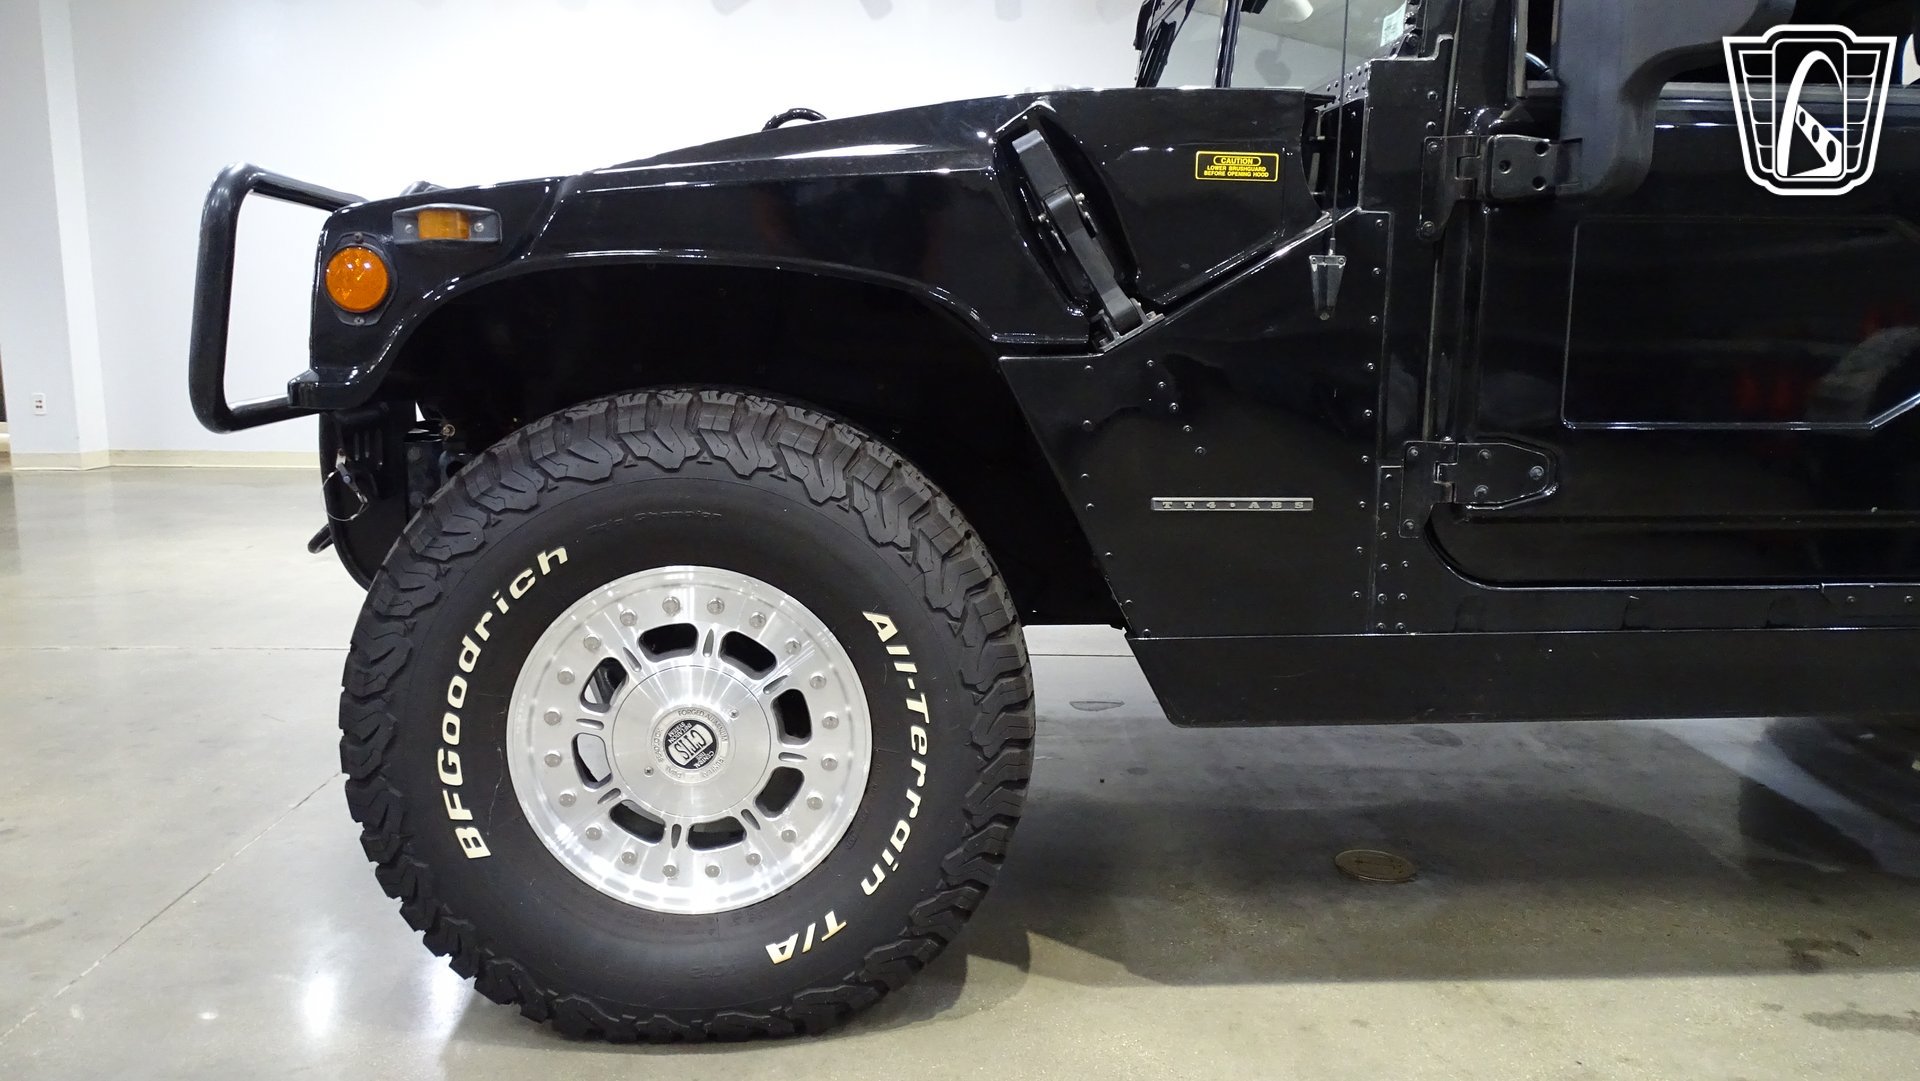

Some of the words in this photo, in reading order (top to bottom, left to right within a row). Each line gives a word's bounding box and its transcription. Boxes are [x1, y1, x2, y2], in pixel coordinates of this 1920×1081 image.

[437, 546, 569, 860] BFGoodrich
[674, 729, 707, 761] CTIS
[860, 610, 931, 896] All-Terrain
[765, 910, 848, 965] T/A
